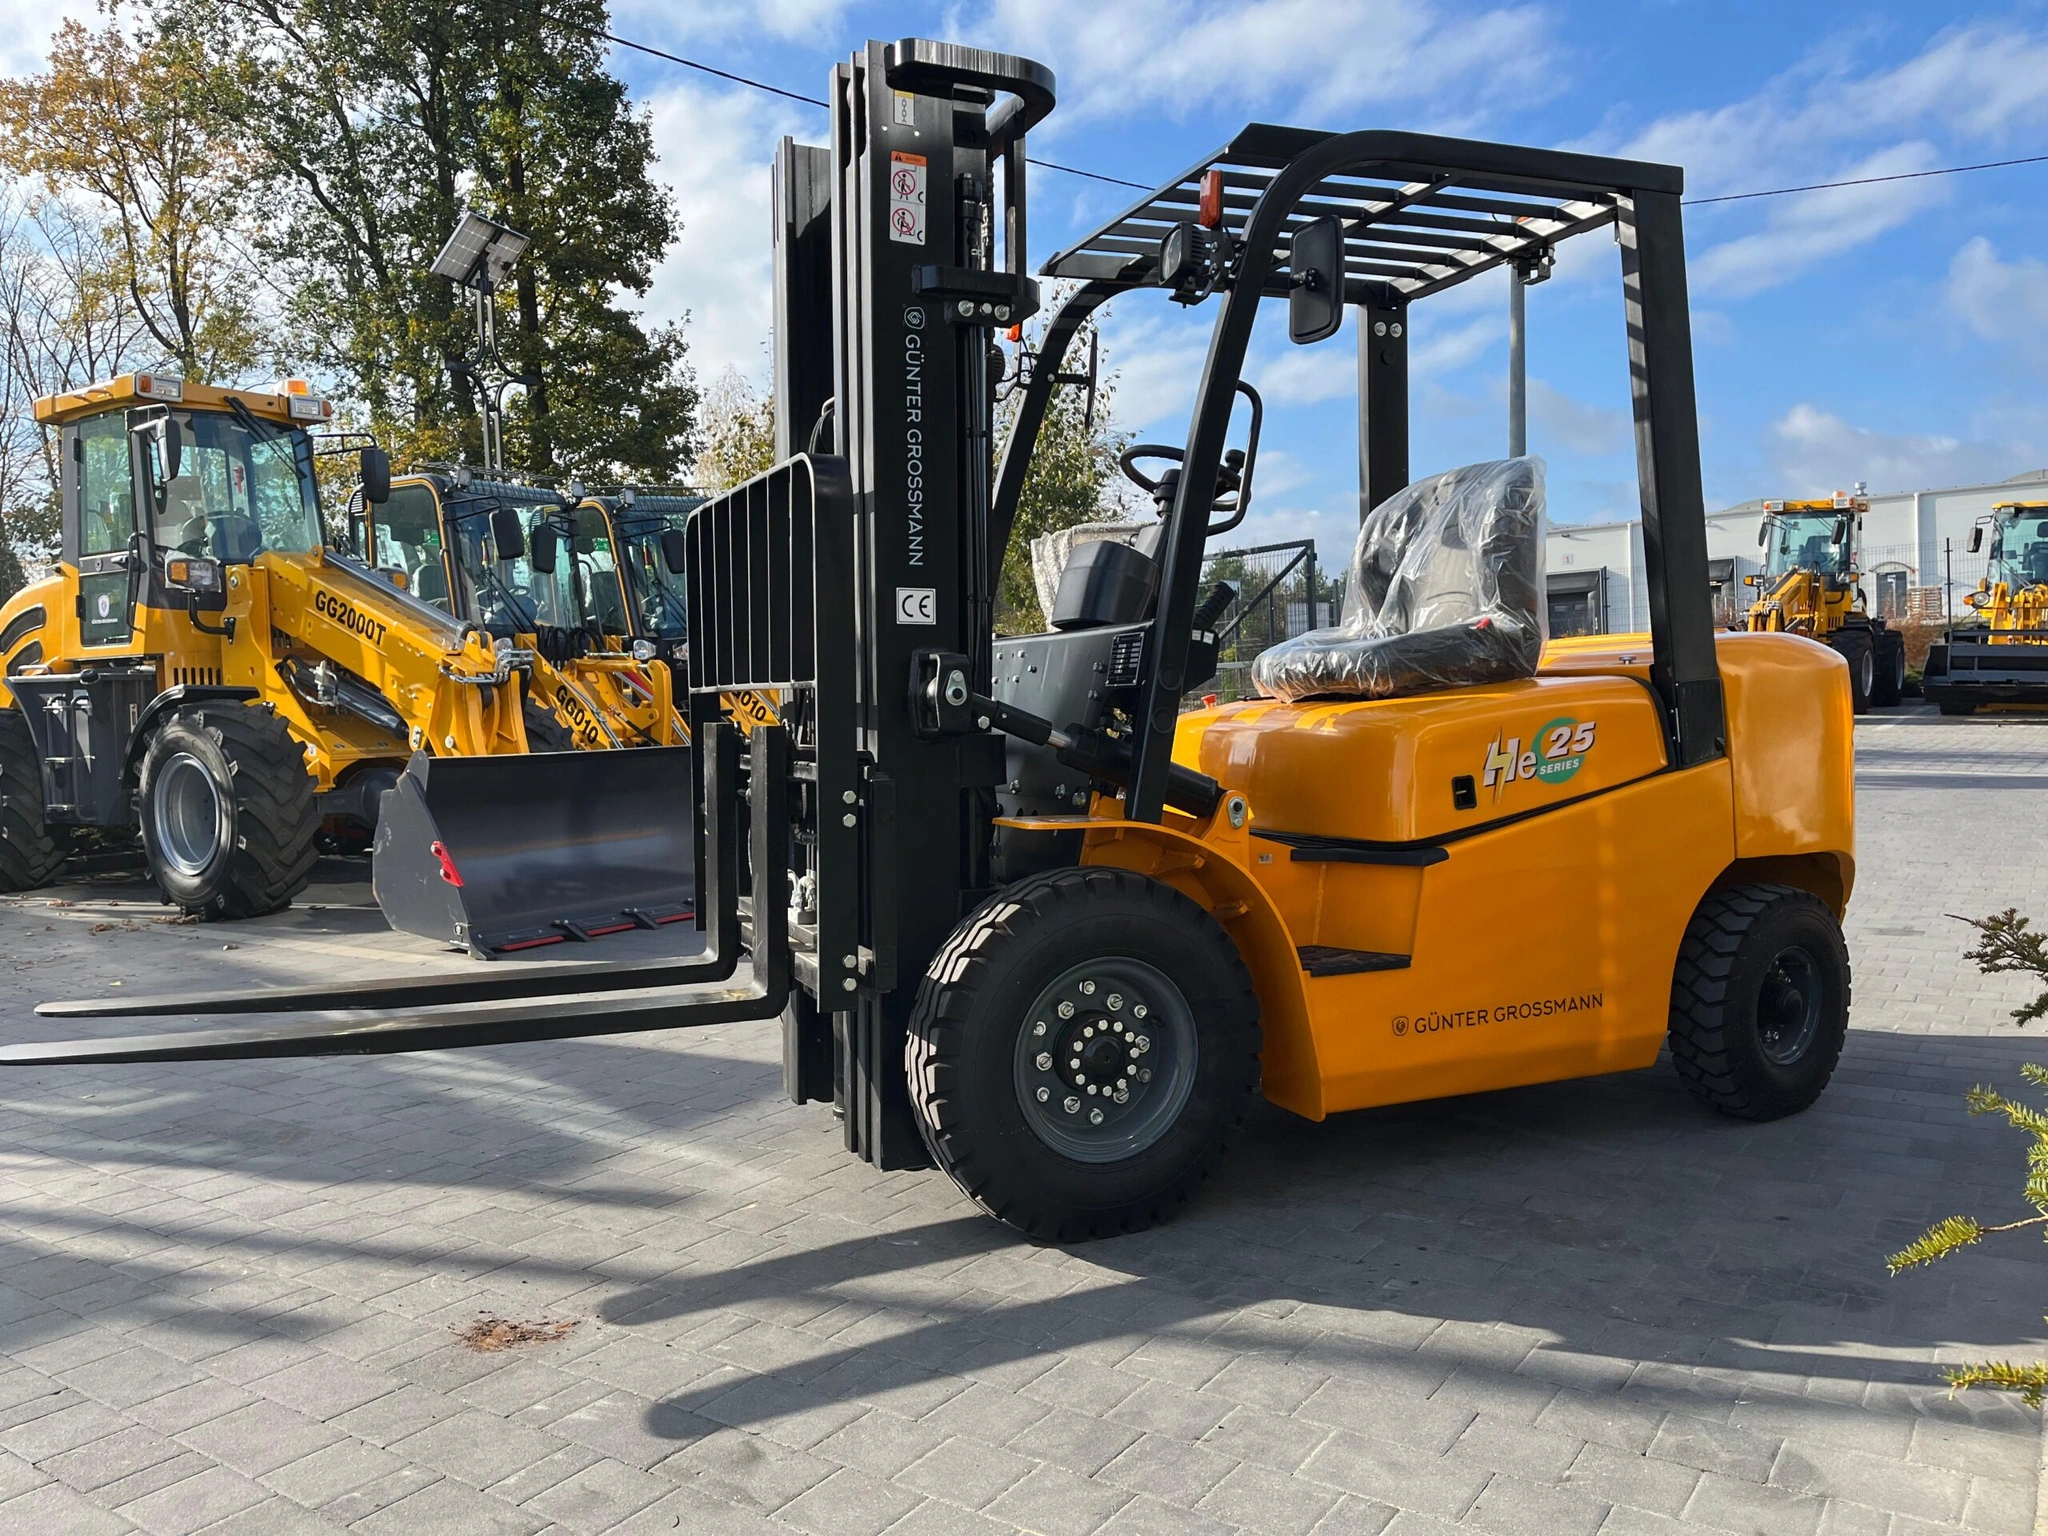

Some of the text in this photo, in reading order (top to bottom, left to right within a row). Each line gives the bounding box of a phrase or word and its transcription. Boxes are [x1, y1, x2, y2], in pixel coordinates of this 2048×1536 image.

[905, 334, 925, 566] GÜNTER GROSSMANN
[315, 589, 387, 646] GG2000T
[902, 594, 931, 619] CE
[556, 685, 599, 744] GG010
[1546, 721, 1597, 760] 25
[1539, 758, 1580, 775] SERIES
[1414, 993, 1604, 1034] GÜNTER GROSSMANN
